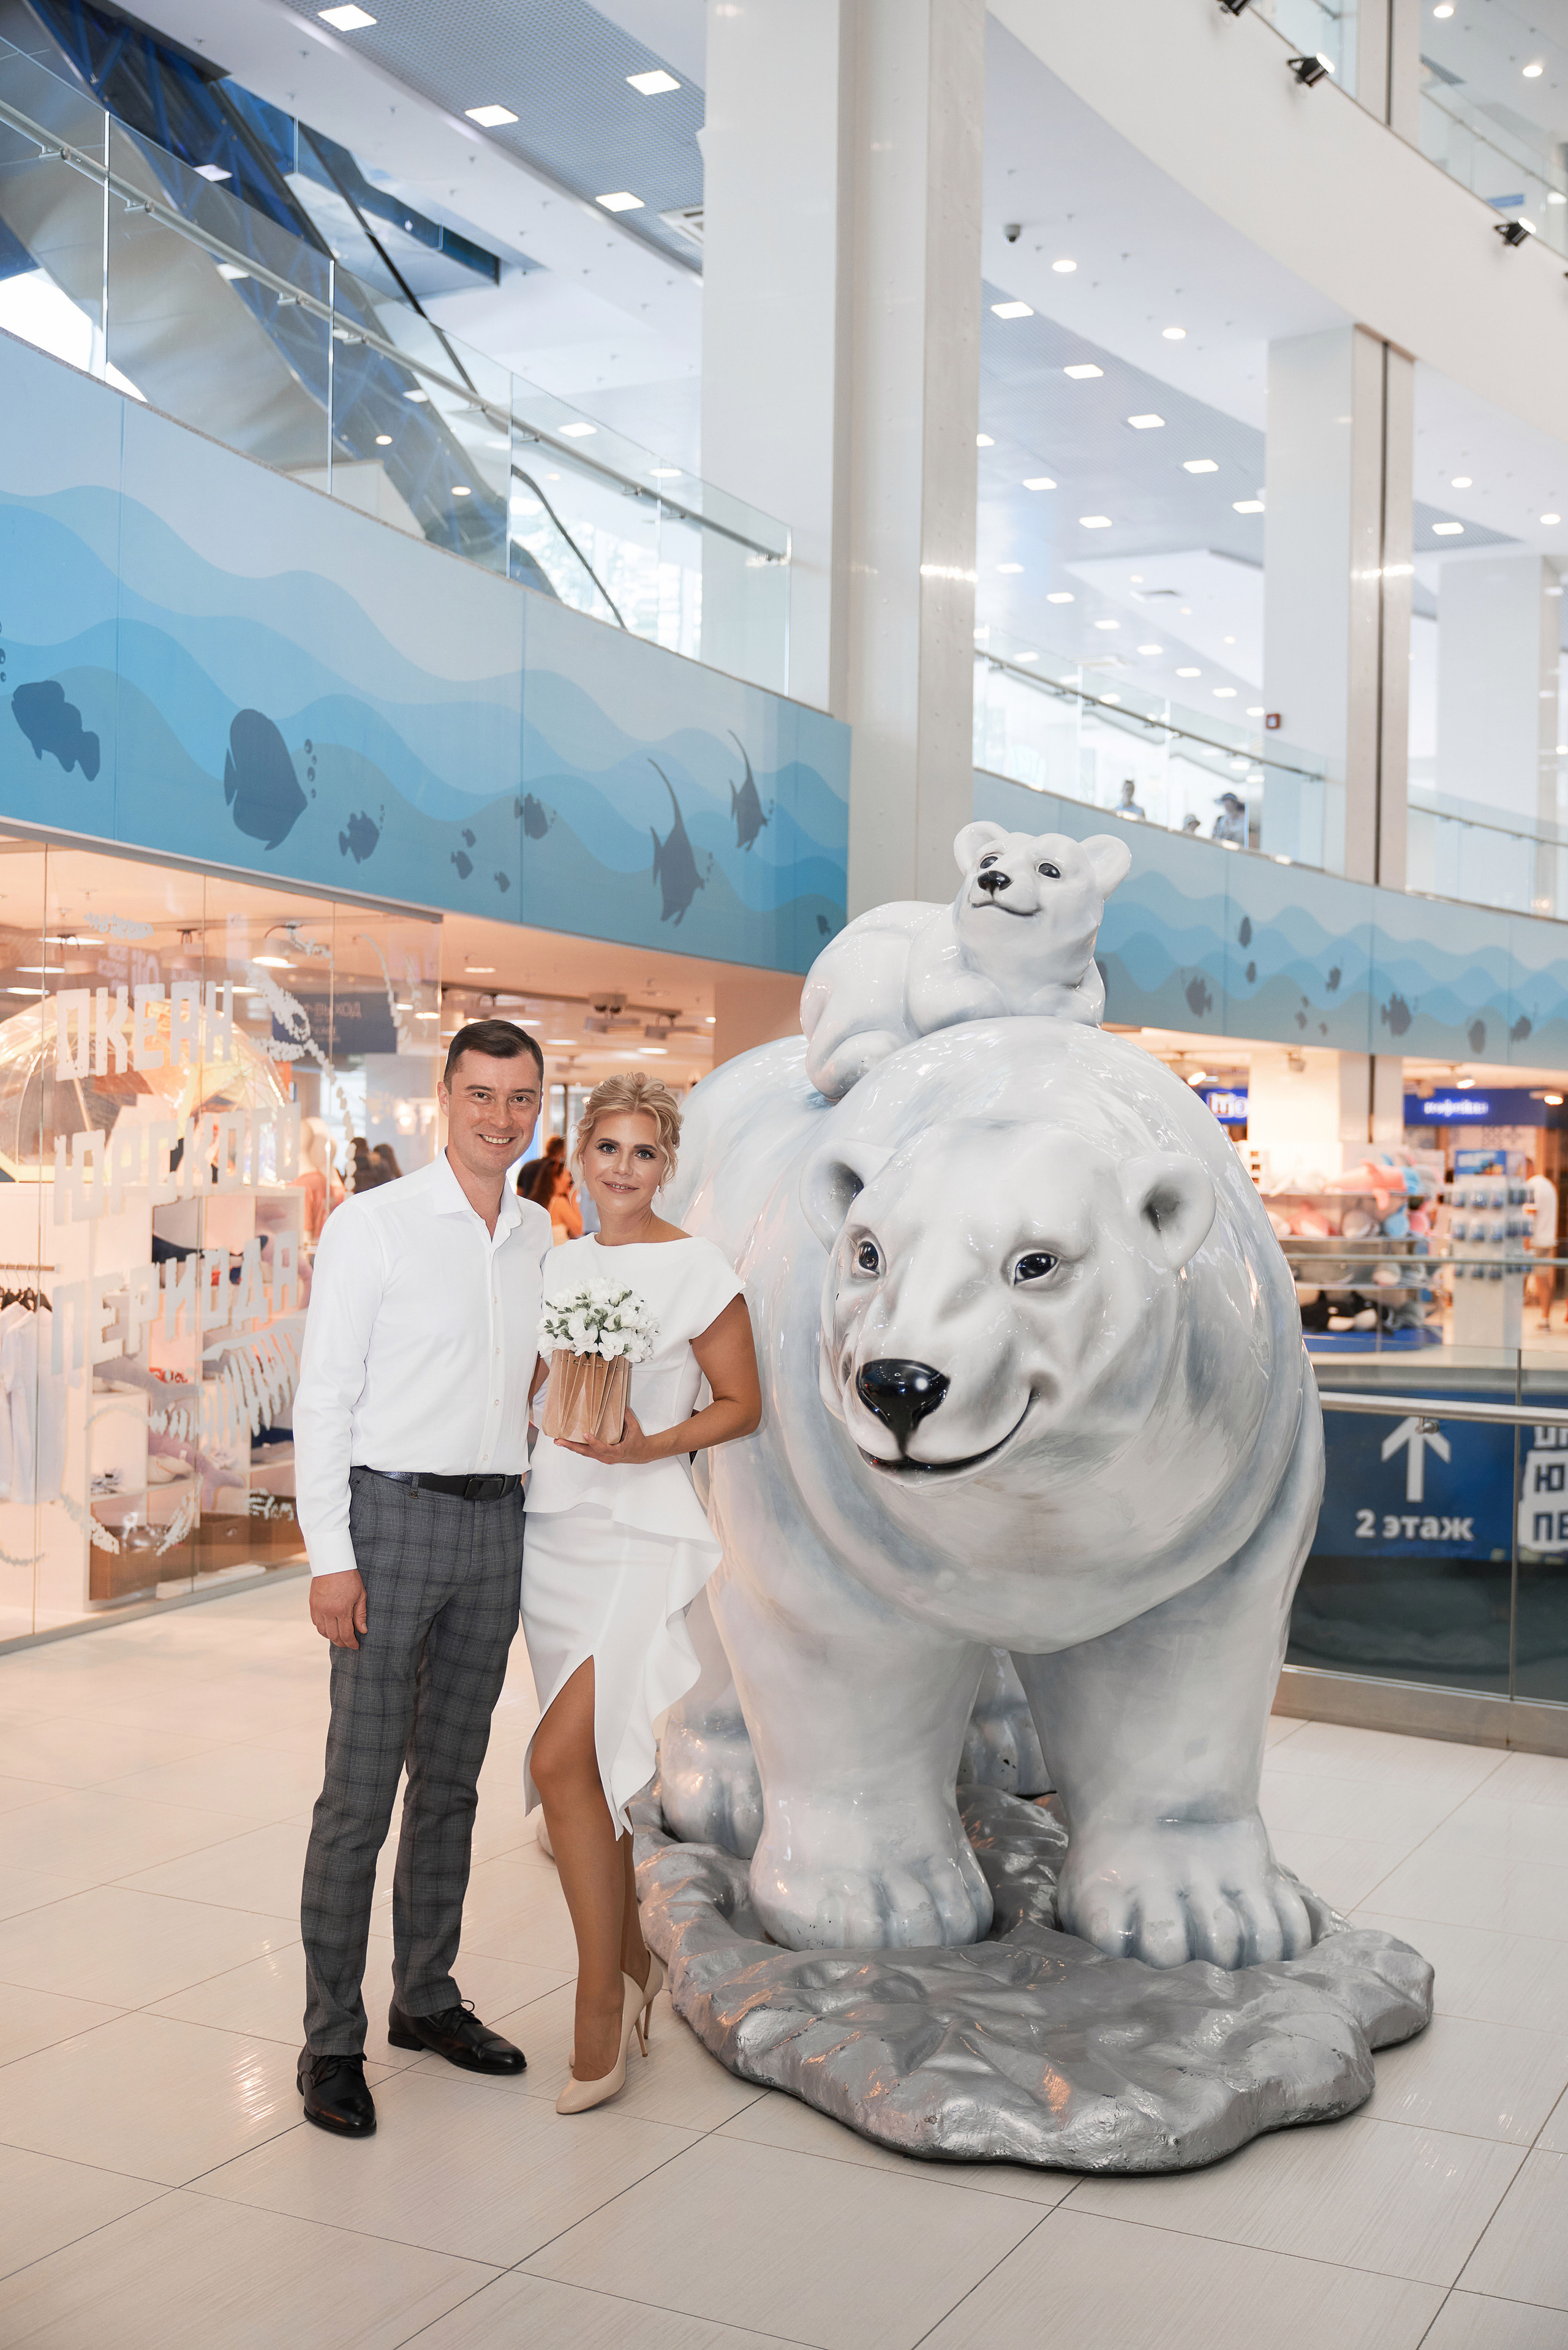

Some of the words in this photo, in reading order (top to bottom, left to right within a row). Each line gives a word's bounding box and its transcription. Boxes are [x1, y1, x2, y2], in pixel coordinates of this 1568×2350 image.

[56, 980, 233, 1082] ОКЕАН
[54, 1102, 301, 1225] ЮРСКОГО
[52, 1230, 298, 1375] ПЕРИОДА
[1355, 1508, 1376, 1538] 2
[1382, 1515, 1474, 1541] этаж
